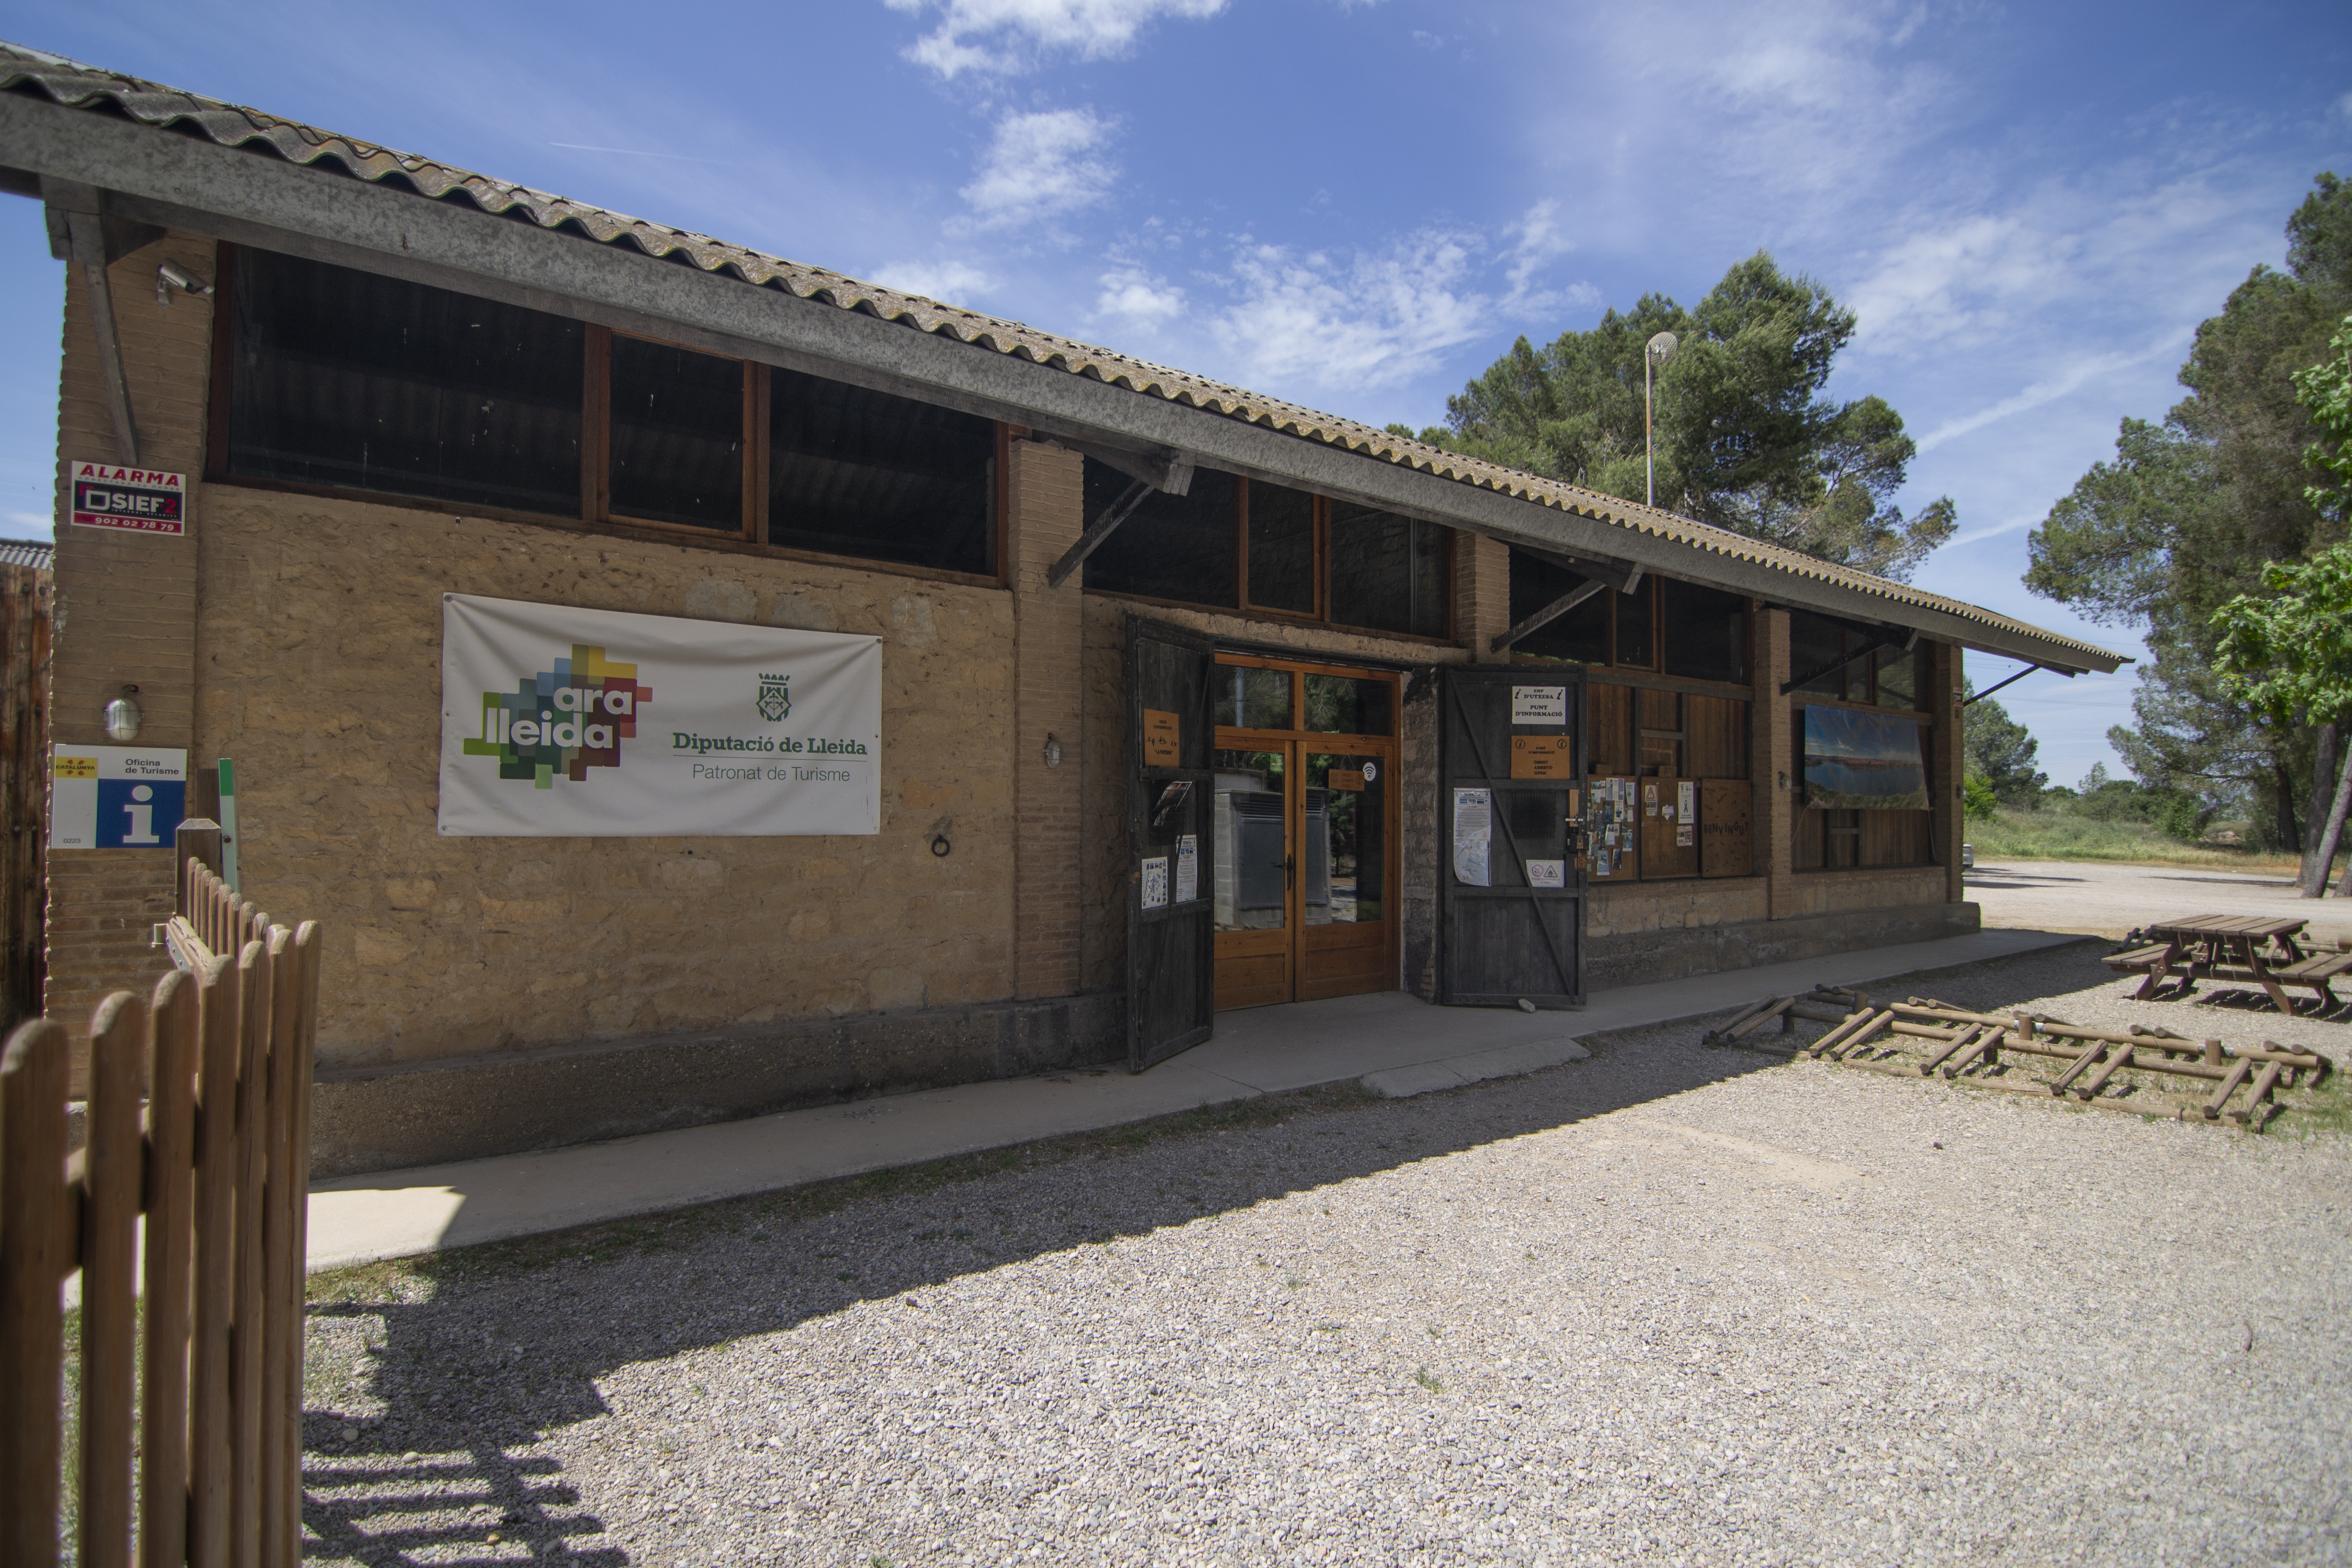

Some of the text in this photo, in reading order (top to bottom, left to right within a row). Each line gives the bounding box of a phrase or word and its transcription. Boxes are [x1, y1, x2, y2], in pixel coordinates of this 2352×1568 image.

[79, 476, 131, 485] CONECTADA
[80, 464, 179, 486] ALARMA
[553, 687, 632, 715] ara
[486, 707, 613, 749] lleida
[673, 732, 867, 755] Diputació de Lleida
[693, 764, 850, 781] Patronat de Turisme
